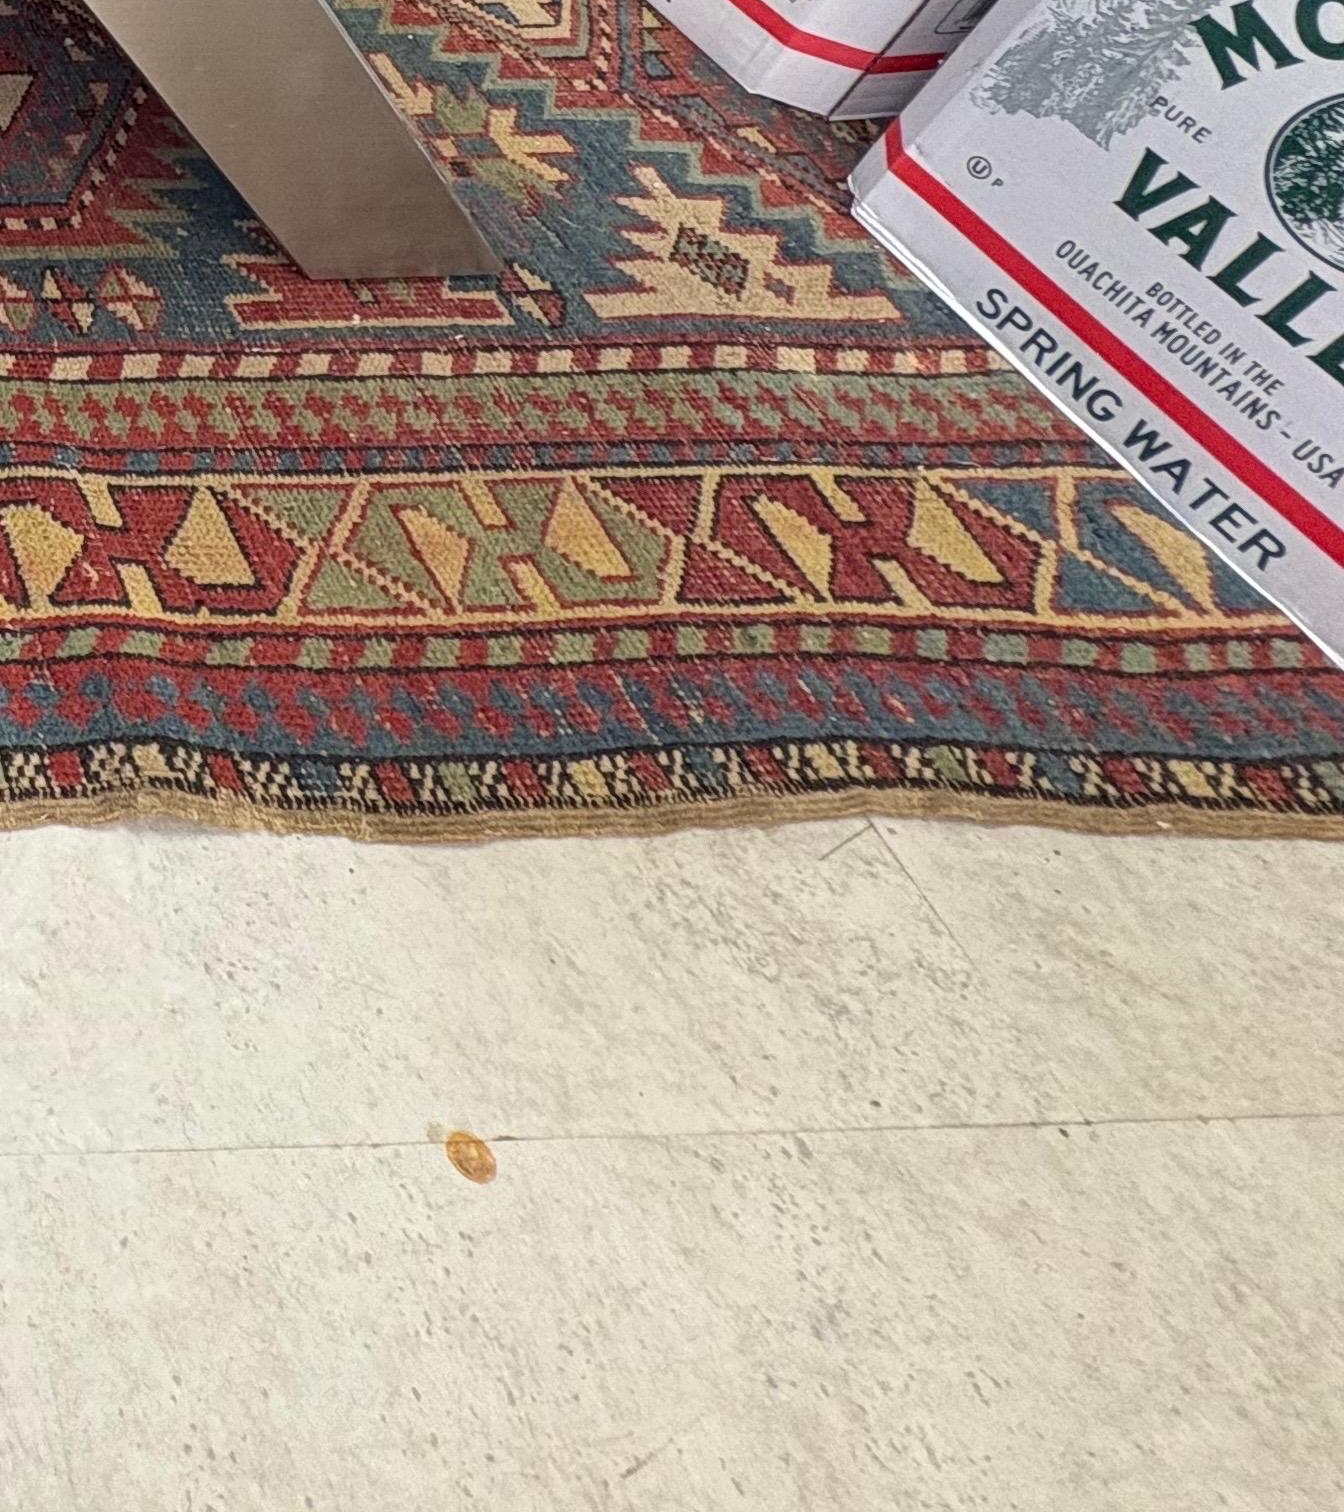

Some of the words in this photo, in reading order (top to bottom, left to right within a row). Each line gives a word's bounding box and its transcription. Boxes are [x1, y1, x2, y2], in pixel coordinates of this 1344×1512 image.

[1149, 95, 1212, 144] PURE
[1055, 240, 1150, 330] OUACHITA
[1151, 319, 1291, 432] MOUNTAINS
[1292, 439, 1344, 489] USA
[1113, 146, 1344, 386] VALL
[1145, 281, 1222, 347] BOTTLED
[1218, 341, 1248, 366] IN
[1242, 360, 1285, 397] THE
[976, 287, 1124, 424] SPRING
[1123, 418, 1288, 572] WATER
